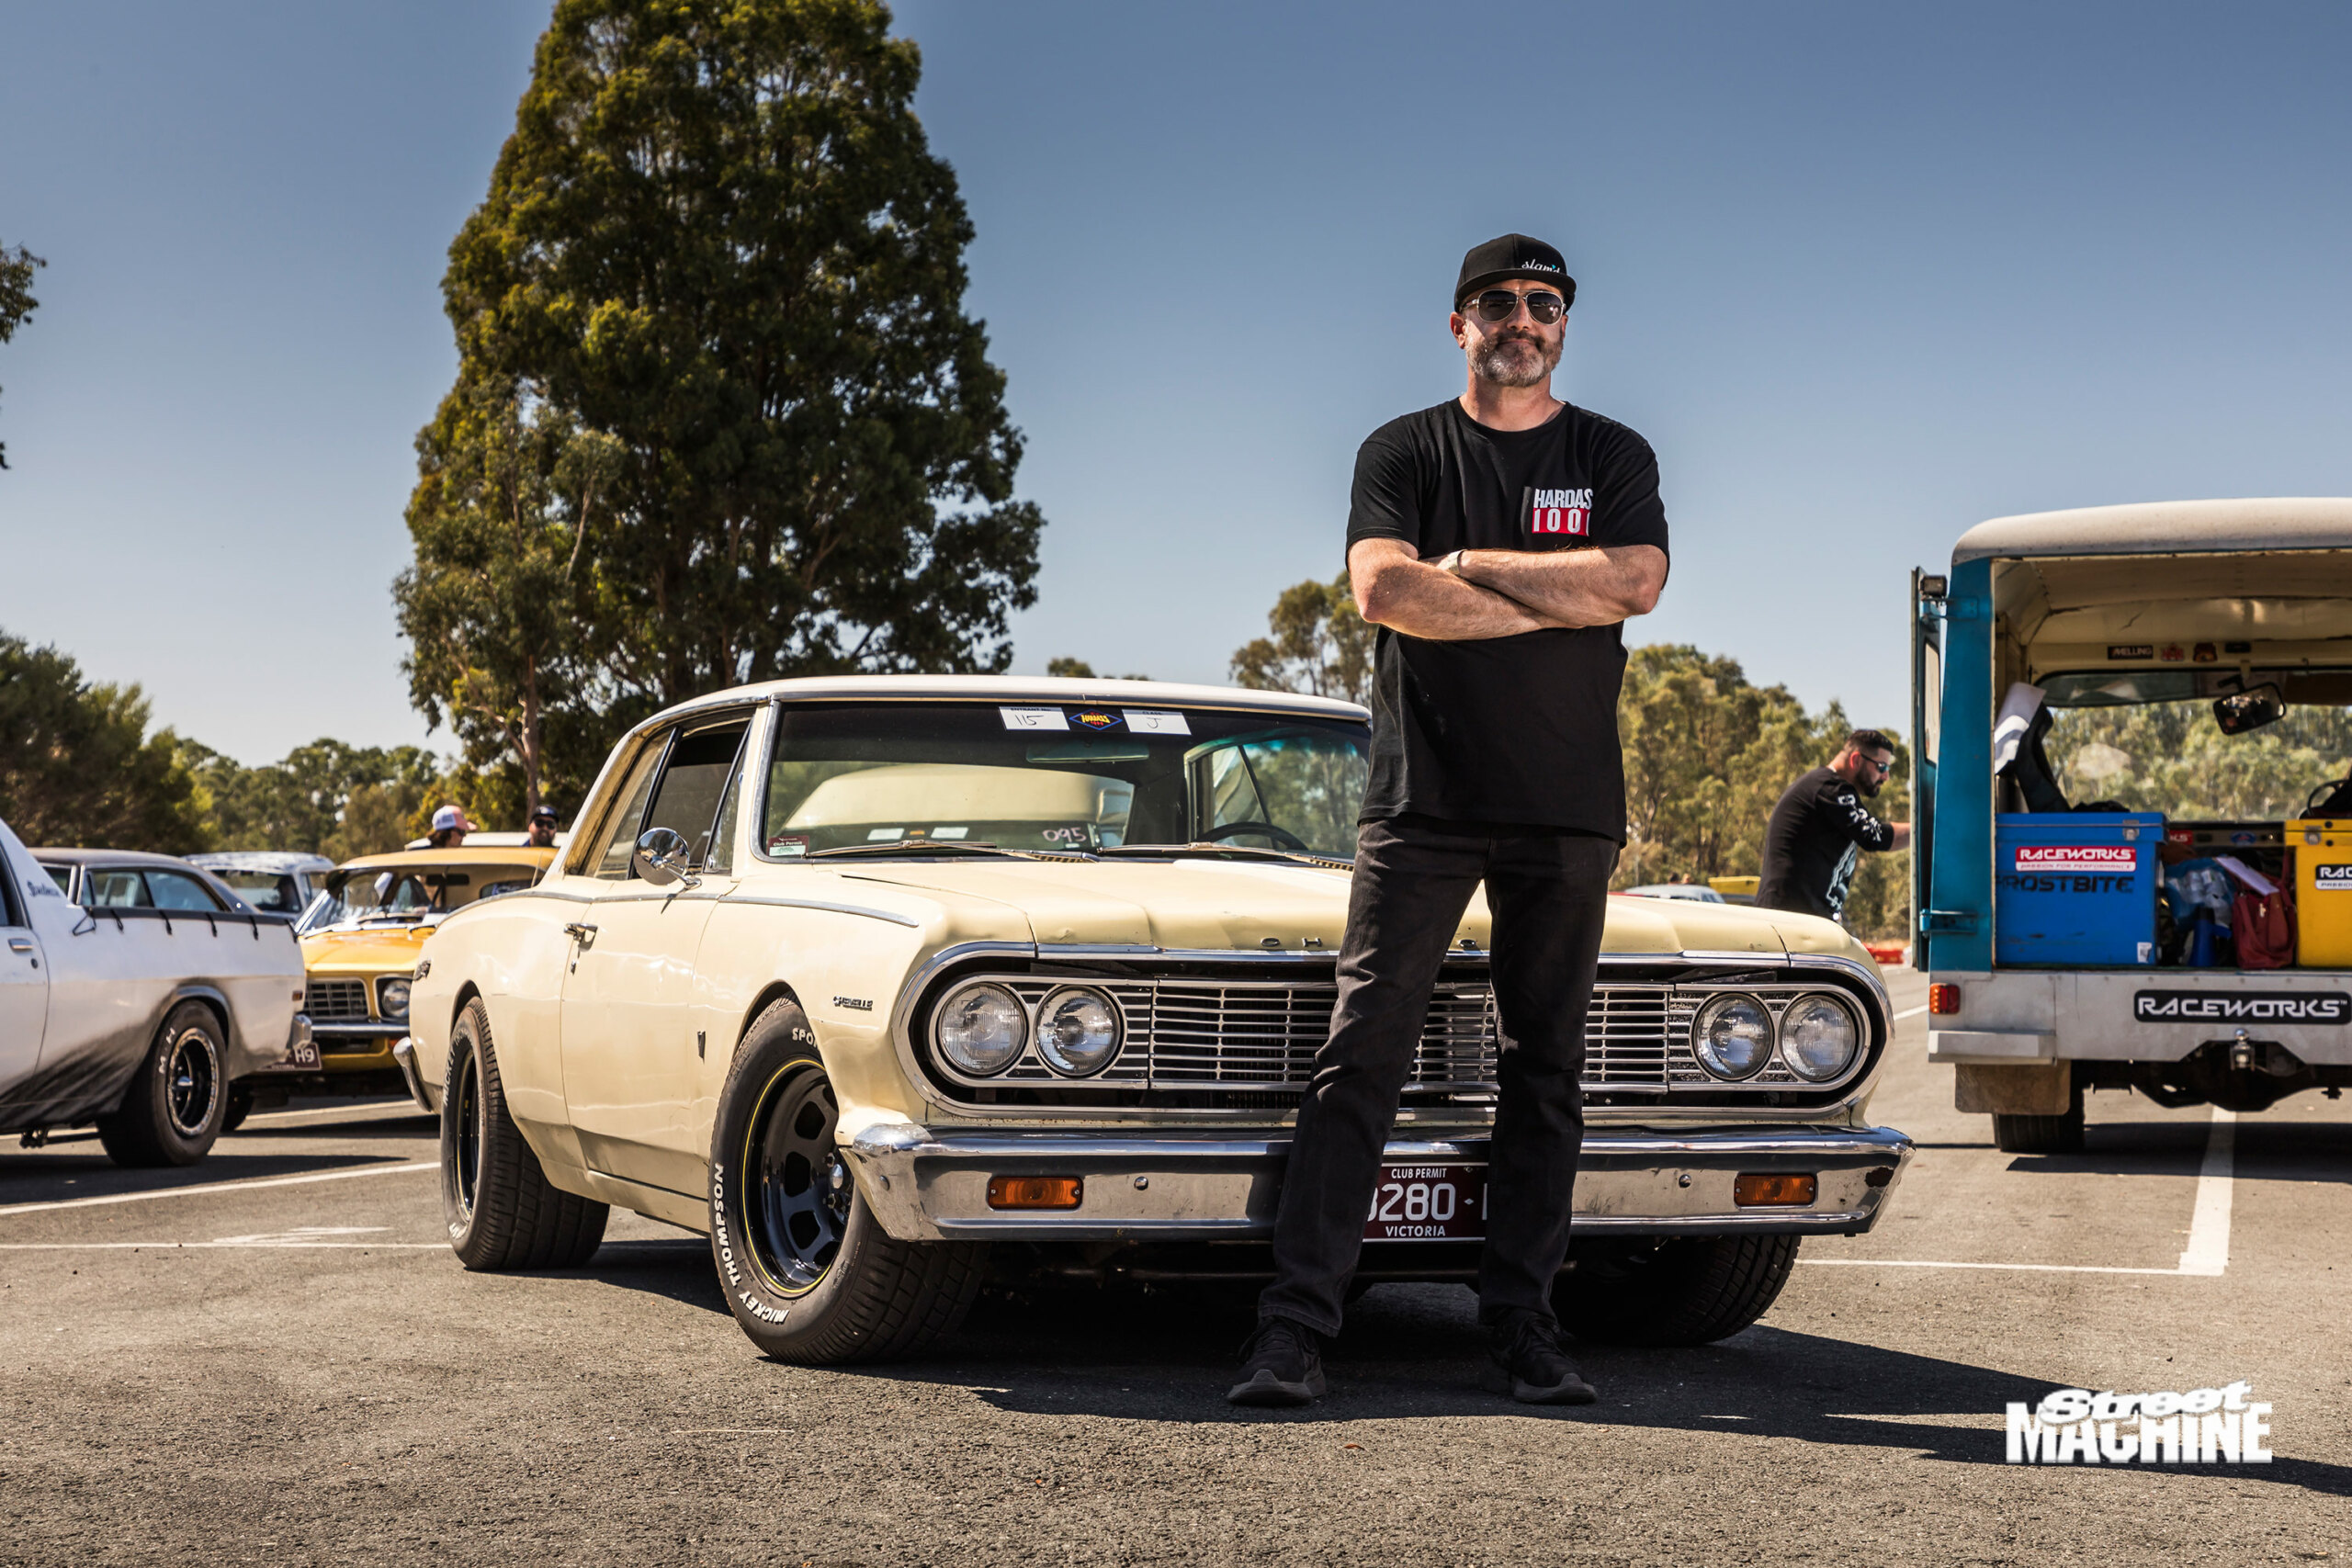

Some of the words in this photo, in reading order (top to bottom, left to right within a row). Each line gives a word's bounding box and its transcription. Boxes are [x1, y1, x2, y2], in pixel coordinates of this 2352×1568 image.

[1533, 508, 1590, 536] 100
[1014, 714, 1045, 727] 115
[1041, 827, 1087, 843] 095
[2020, 848, 2132, 860] RACEWORKS
[2138, 997, 2341, 1018] RACEWORKS
[792, 1027, 818, 1048] SPO
[1391, 1168, 1414, 1179] CLUB
[1415, 1168, 1448, 1179] PERMIT
[714, 1162, 742, 1288] THOMPSON
[1385, 1224, 1447, 1237] VICTORIA
[739, 1290, 790, 1324] MICKEY
